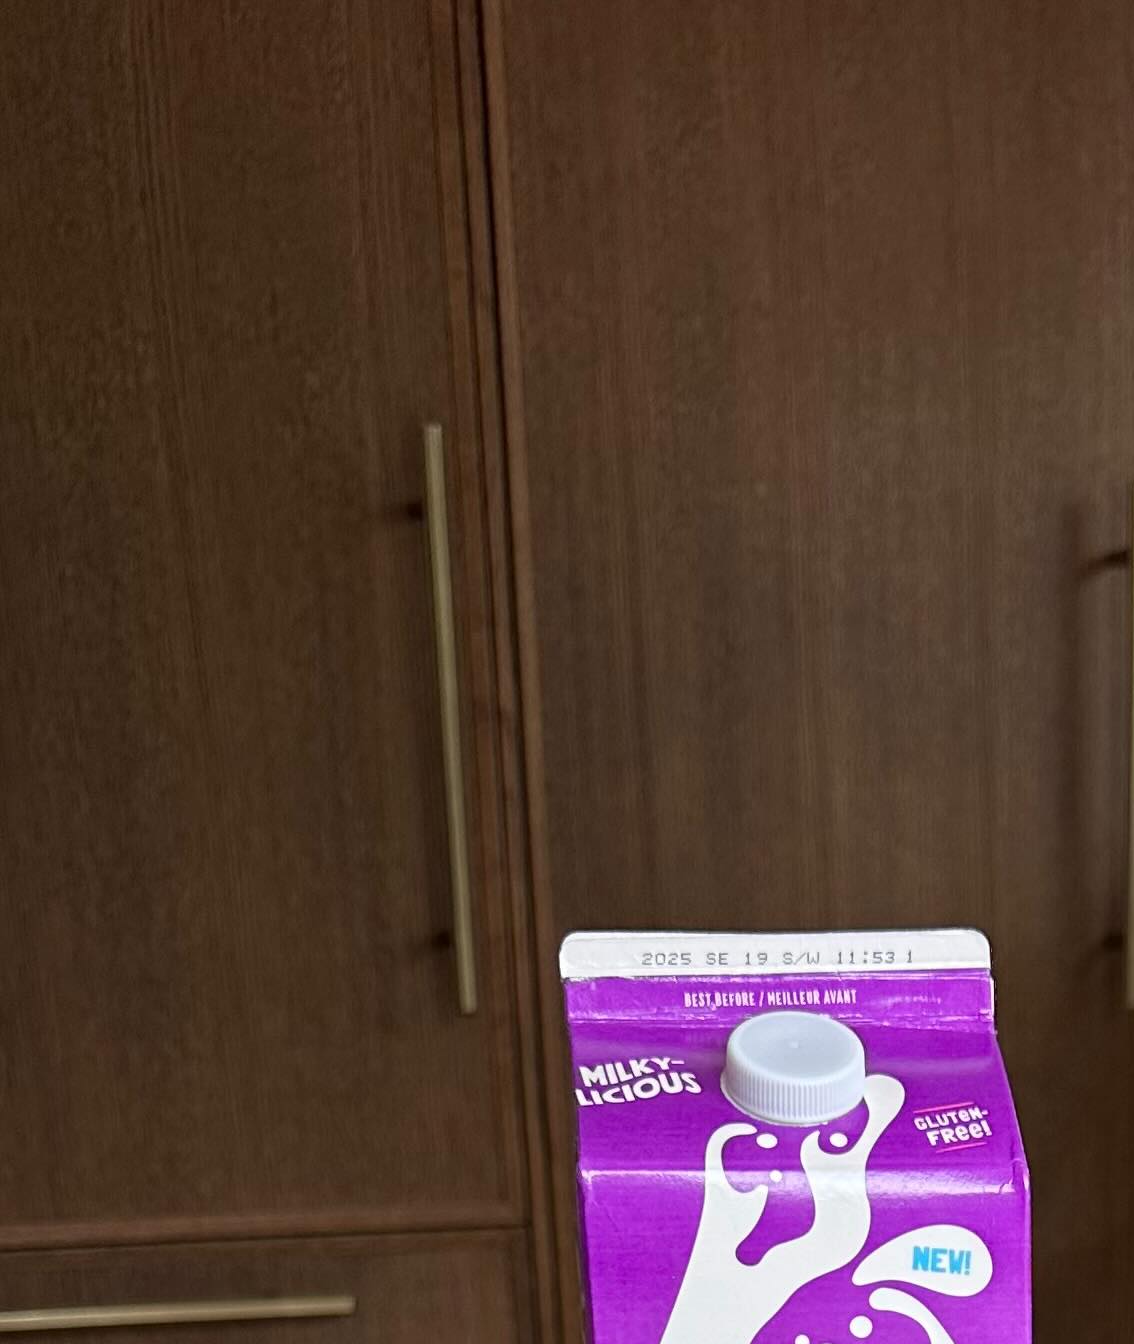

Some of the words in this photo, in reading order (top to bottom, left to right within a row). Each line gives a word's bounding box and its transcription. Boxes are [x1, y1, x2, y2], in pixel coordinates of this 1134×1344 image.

[641, 952, 692, 966] 2025
[705, 952, 729, 966] SE
[744, 952, 768, 966] 19
[837, 950, 895, 964] 11:53
[684, 992, 711, 1008] BEST
[713, 991, 755, 1008] BEFORE
[758, 991, 764, 1007] /
[767, 990, 820, 1006] MEILLEUR
[823, 989, 857, 1005] AVANT
[579, 1056, 685, 1088] MILKY-
[575, 1071, 702, 1106] LICIOUS
[911, 1246, 971, 1275] NEW!
